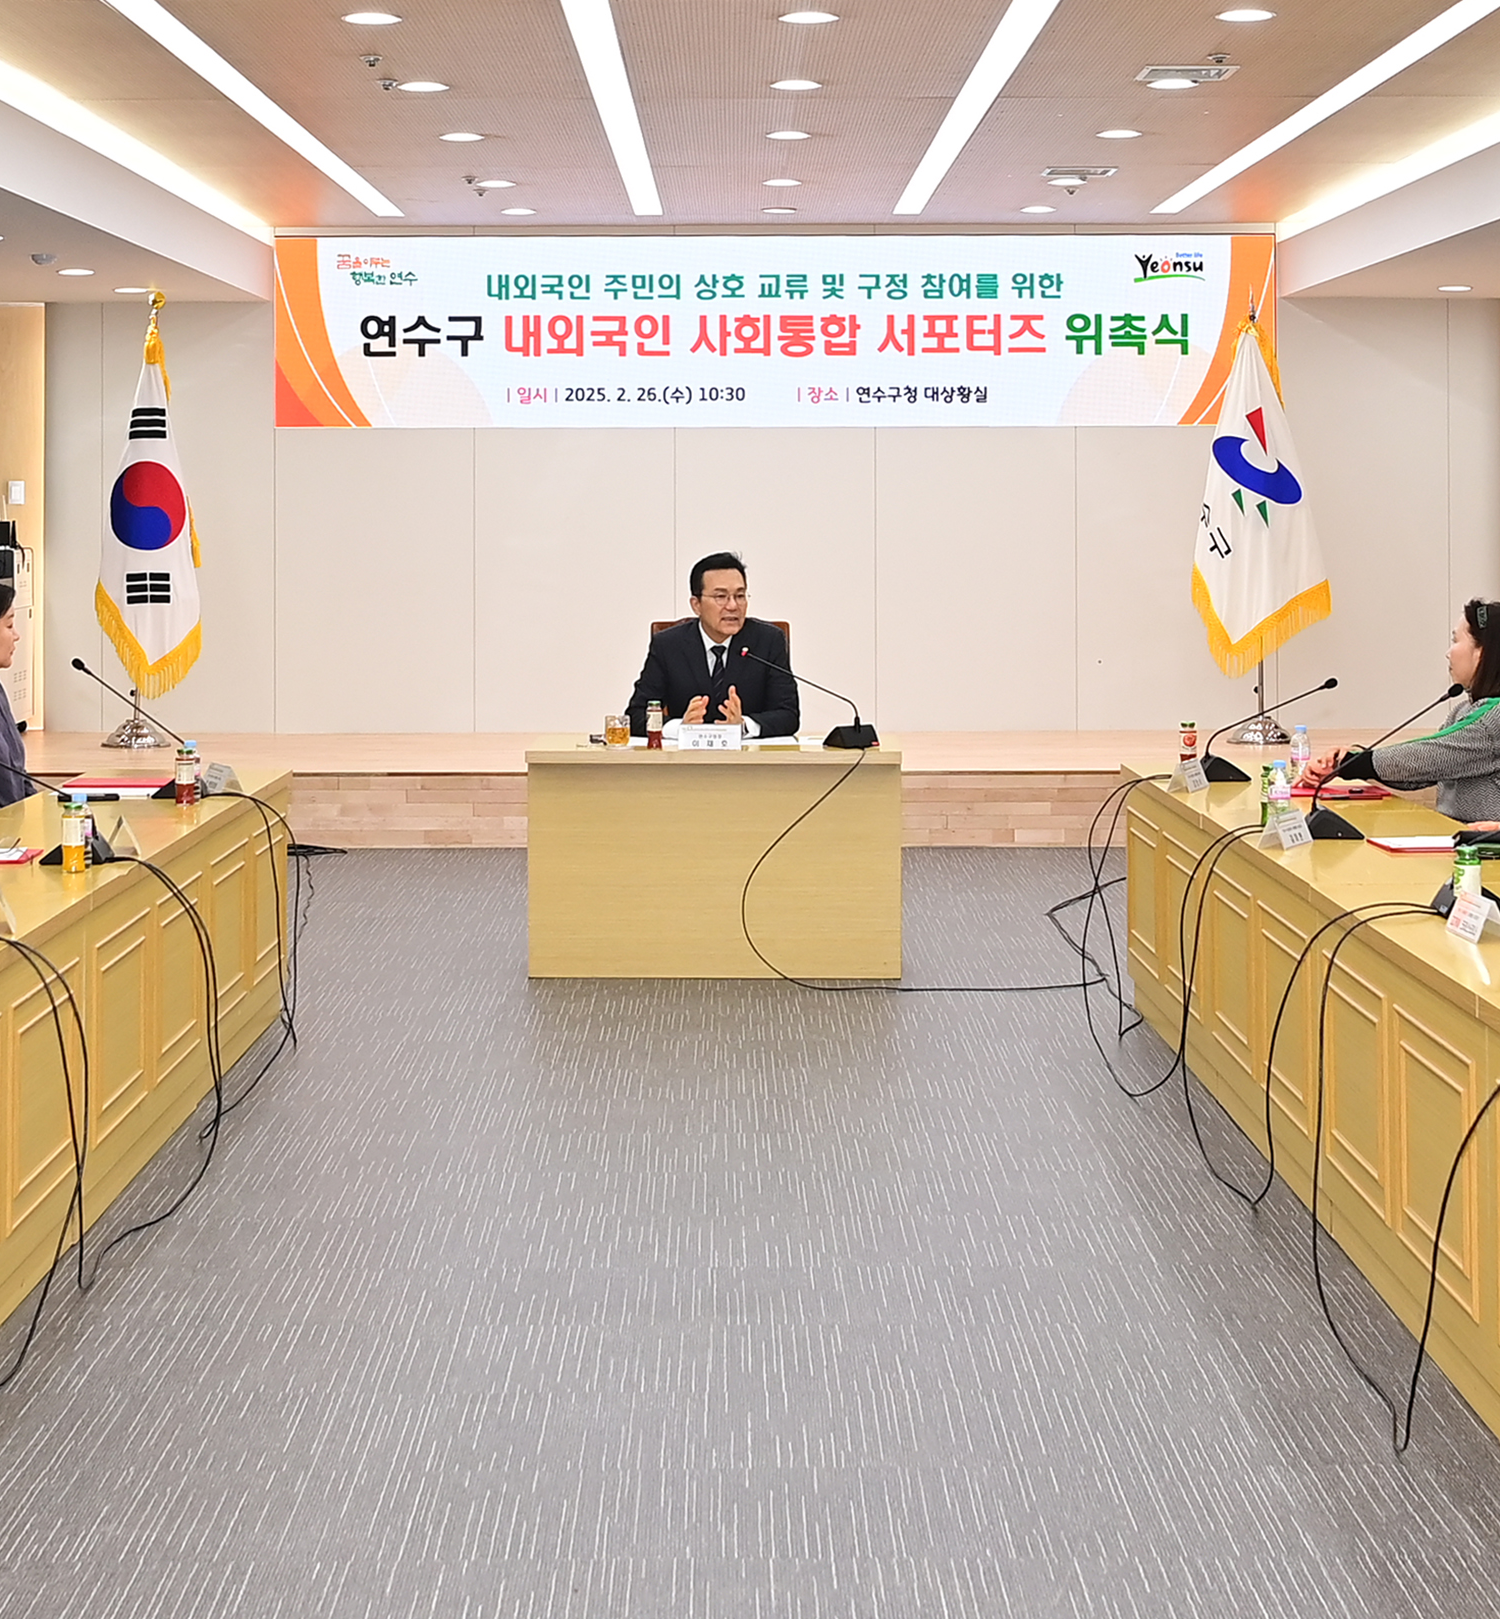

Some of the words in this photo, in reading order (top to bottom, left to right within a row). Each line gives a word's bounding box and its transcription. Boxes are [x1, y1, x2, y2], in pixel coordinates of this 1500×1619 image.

[1134, 253, 1203, 279] Yeonsu
[389, 271, 418, 286] 연수
[487, 273, 590, 300] 내외국인
[604, 273, 681, 300] 주민의
[694, 273, 745, 300] 상호
[758, 273, 809, 300] 교류
[822, 273, 844, 299] 및
[858, 273, 908, 300] 구정
[921, 273, 999, 299] 참여를
[1011, 273, 1064, 299] 위한
[360, 315, 484, 357] 연수구
[505, 315, 670, 357] 내외국인
[690, 314, 861, 357] 사회통합
[877, 314, 1046, 356] 서포터즈
[1065, 313, 1189, 356] 위촉식
[517, 387, 546, 404] 일시
[565, 387, 610, 402] 2025.
[617, 387, 631, 402] 2.
[637, 386, 692, 405] 26.(수)
[699, 387, 745, 402] 10:30
[808, 387, 838, 404] 장소
[856, 385, 917, 404] 연수구청
[924, 385, 987, 404] 대상황실
